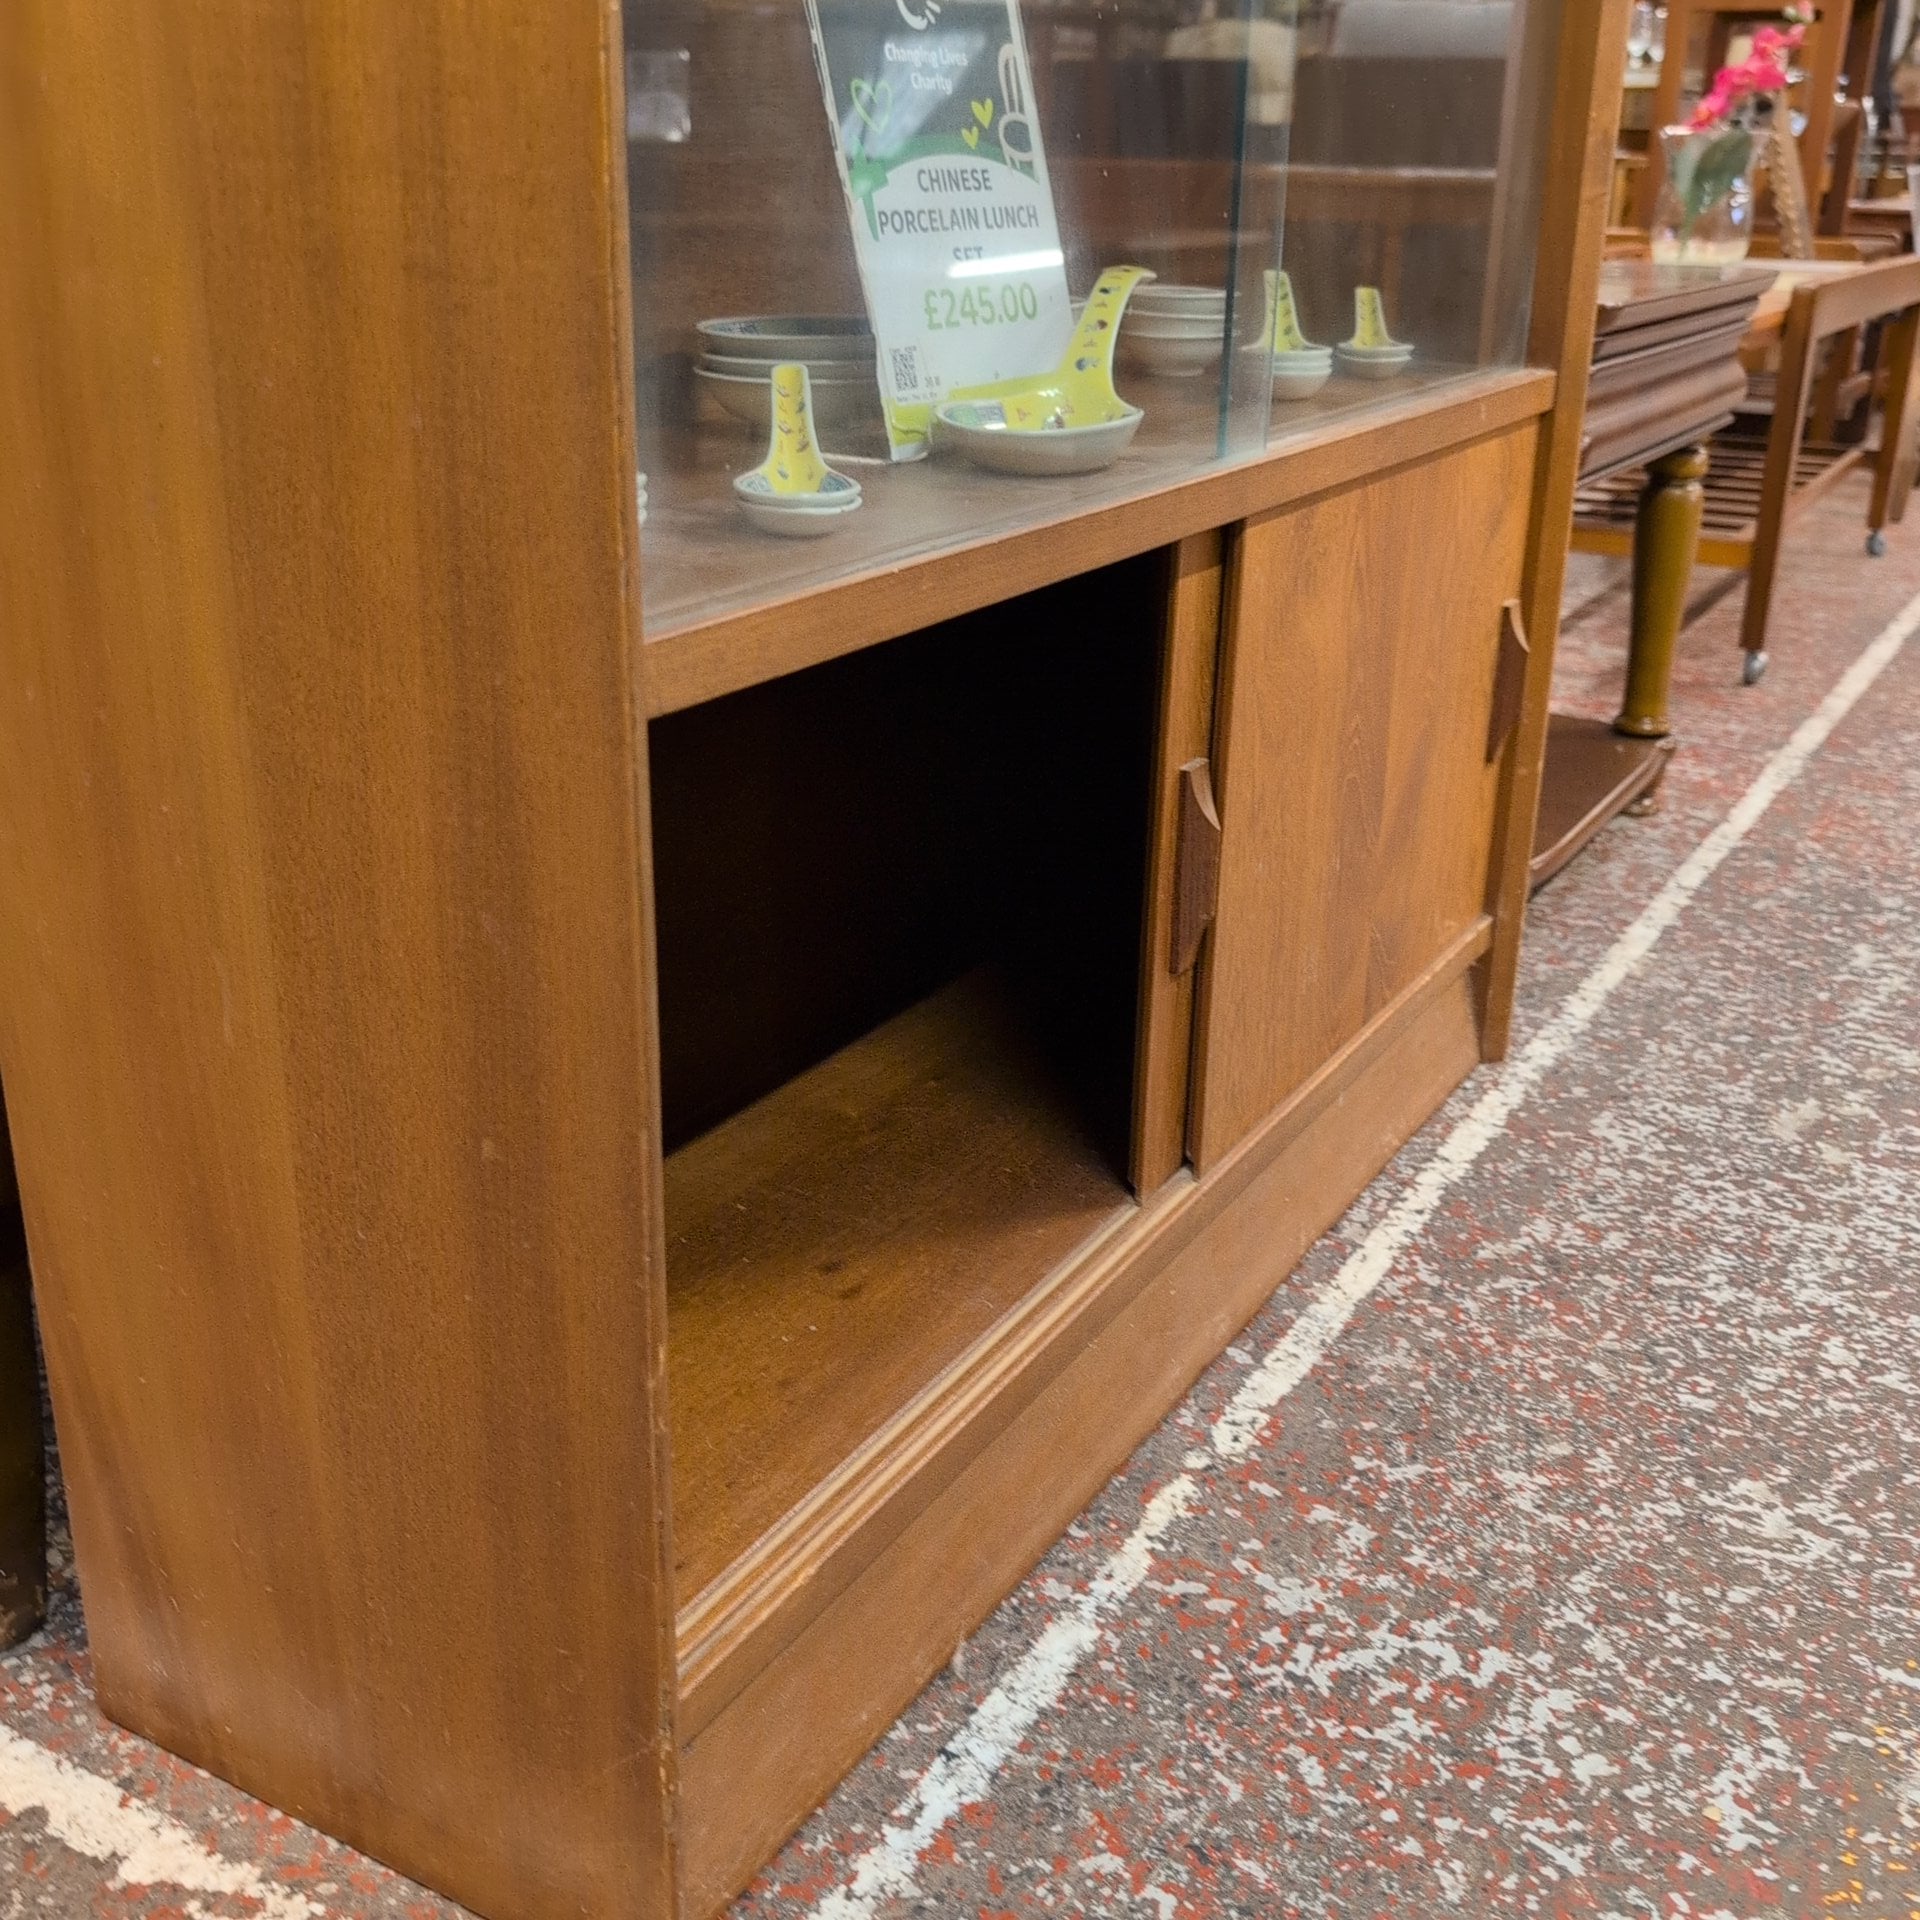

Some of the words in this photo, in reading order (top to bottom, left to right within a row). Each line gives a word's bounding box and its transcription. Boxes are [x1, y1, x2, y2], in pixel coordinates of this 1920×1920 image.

[884, 42, 937, 67] Changing
[938, 49, 968, 67] Lives
[911, 74, 952, 94] Charity
[917, 169, 993, 192] CHINESE
[878, 207, 980, 235] PORCELAIN
[983, 205, 1039, 230] LUNCH
[924, 283, 1038, 330] £245.00
